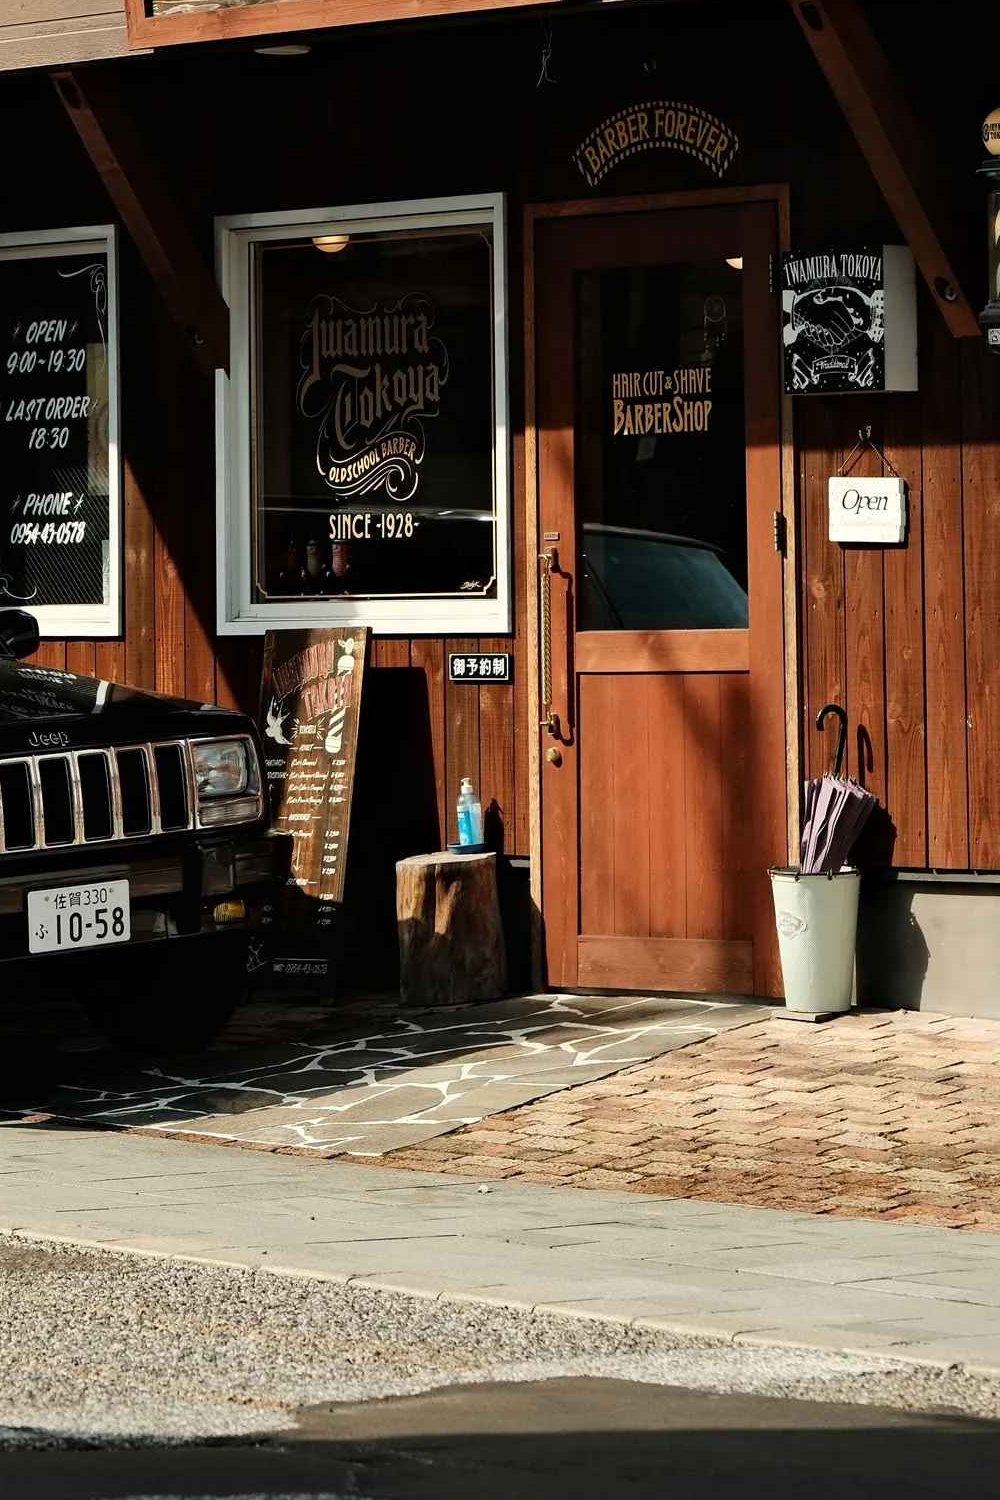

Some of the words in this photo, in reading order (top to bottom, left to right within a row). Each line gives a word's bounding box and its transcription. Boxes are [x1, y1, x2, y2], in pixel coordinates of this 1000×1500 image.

[584, 111, 650, 173] BARBER
[654, 108, 729, 165] FOREVER
[784, 255, 838, 286] IWAMURA
[840, 254, 881, 281] TOKOYA
[25, 320, 67, 343] OPEN
[300, 305, 430, 414] Iwamura
[612, 372, 641, 398] HAIR
[642, 370, 664, 396] CUT
[664, 376, 673, 389] &
[673, 367, 712, 394] SHAVE
[5, 398, 45, 421] LAST
[45, 396, 90, 420] ORDER
[331, 361, 440, 450] Tokoya
[29, 427, 69, 449] 18:30
[381, 437, 417, 460] BARBER
[23, 492, 73, 515] PHONE
[842, 488, 888, 514] Open
[10, 521, 86, 544] 0954-43-0578
[329, 513, 371, 539] SINCE
[453, 657, 505, 676] 御予約制
[29, 731, 70, 747] Jeep
[35, 923, 49, 940] ふ
